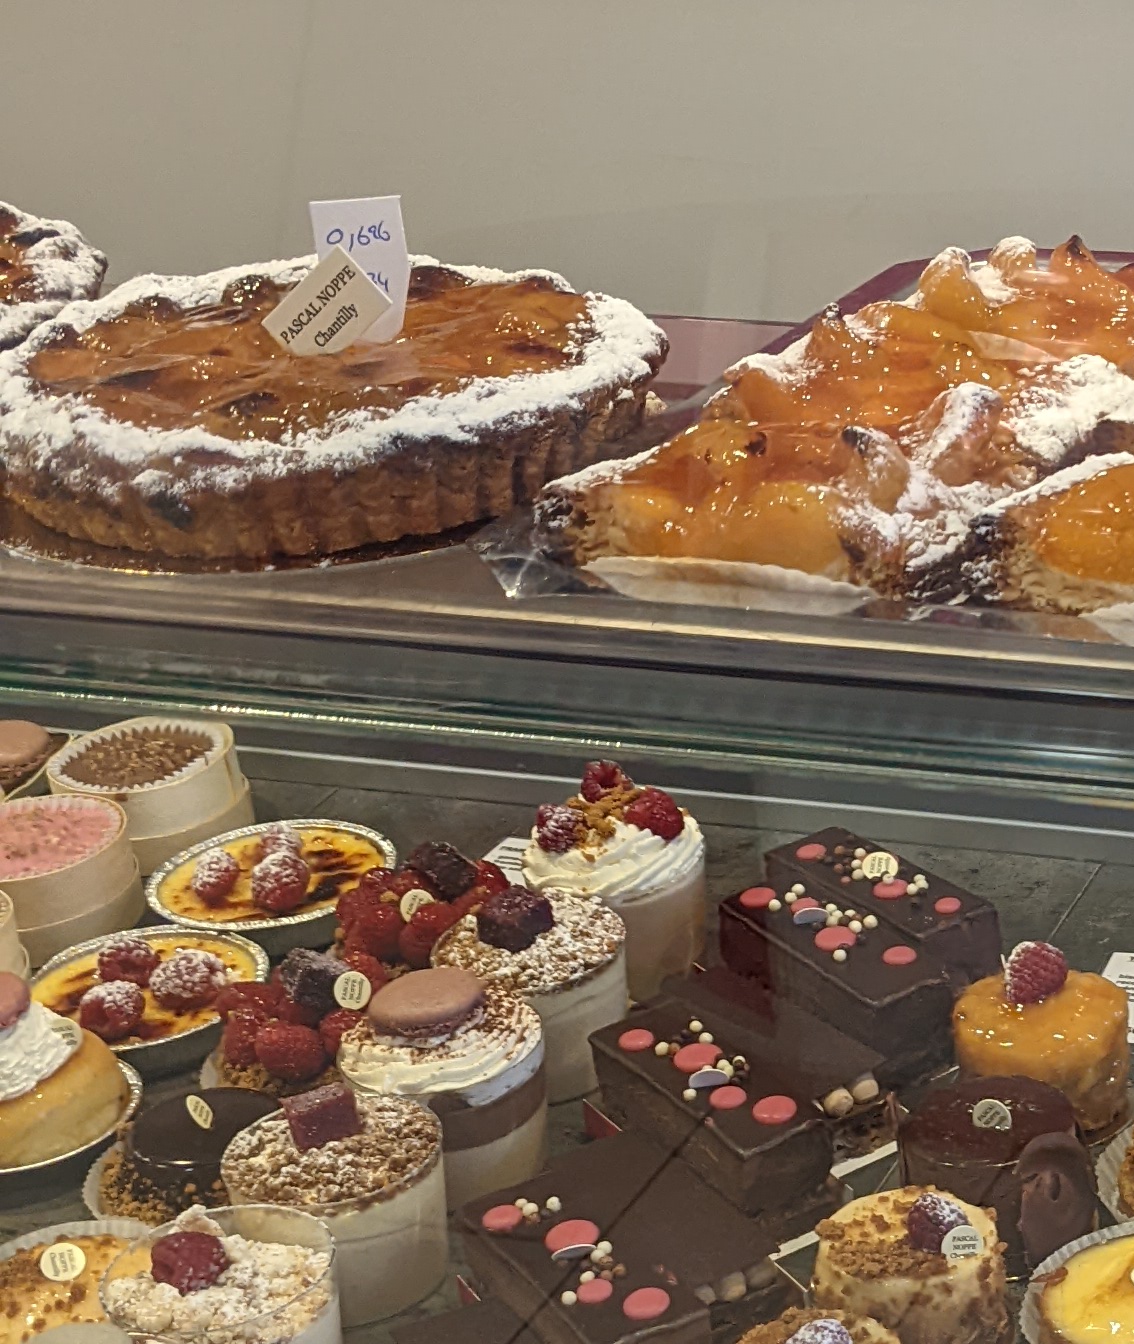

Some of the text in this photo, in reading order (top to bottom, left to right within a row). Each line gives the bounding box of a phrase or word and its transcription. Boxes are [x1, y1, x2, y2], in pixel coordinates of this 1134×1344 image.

[280, 264, 357, 345] PASCAL NOPPE
[314, 303, 359, 347] Chantilly
